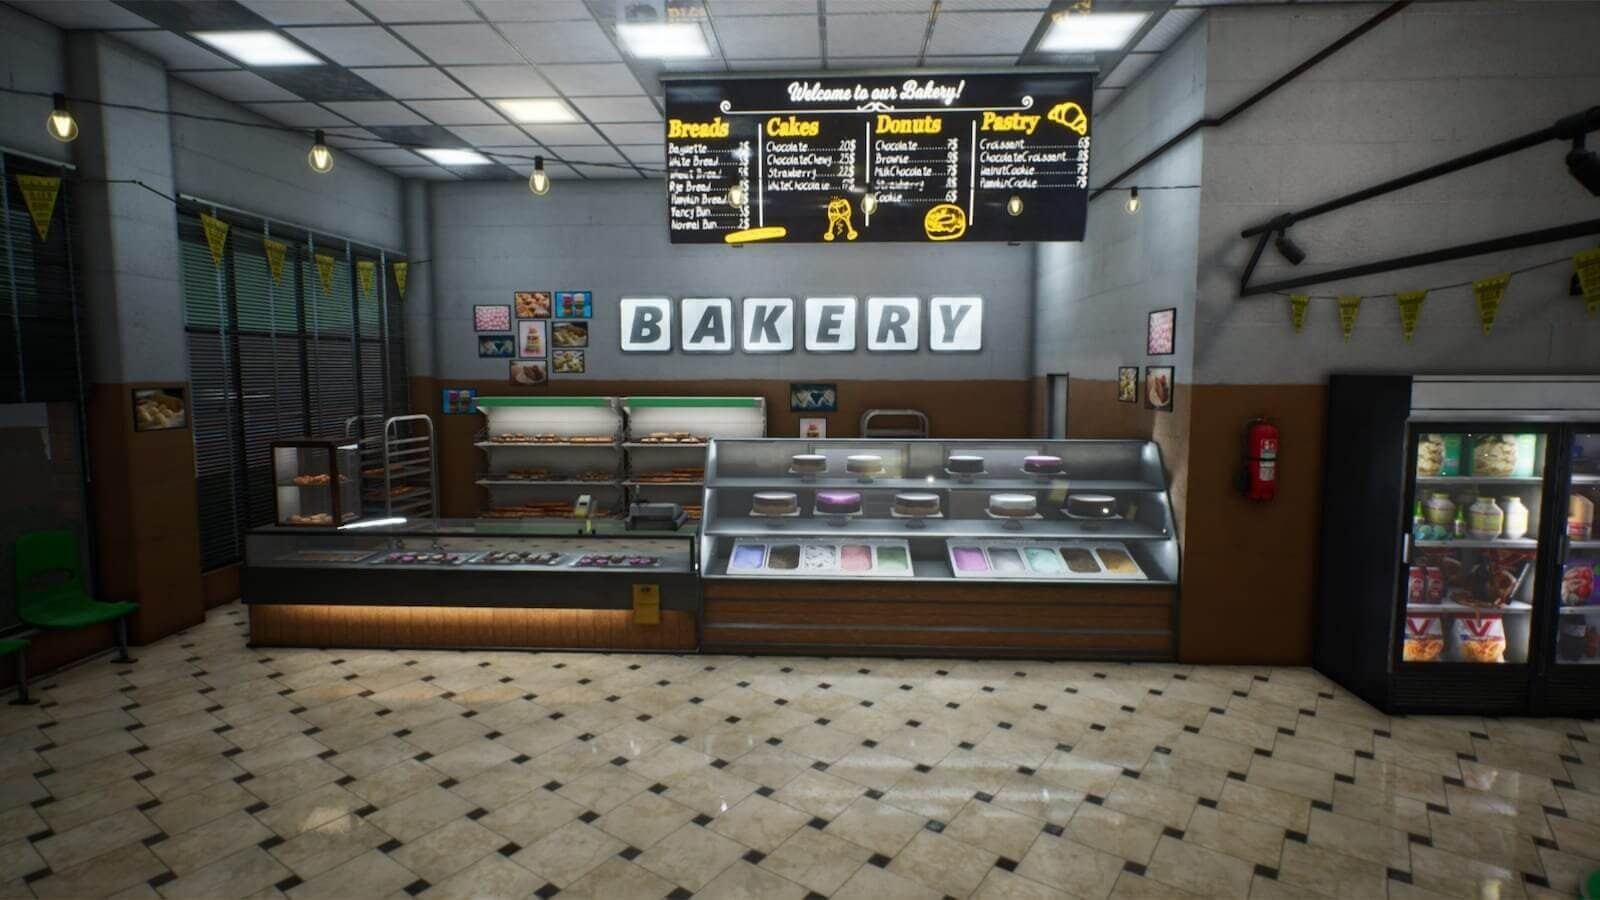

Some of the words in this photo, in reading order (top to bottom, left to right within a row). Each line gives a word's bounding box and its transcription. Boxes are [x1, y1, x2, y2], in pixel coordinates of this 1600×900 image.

[787, 81, 852, 102] Welcome
[853, 83, 869, 100] to
[871, 86, 898, 100] our
[900, 79, 966, 105] Bakery!
[668, 116, 730, 138] Breads
[766, 116, 819, 136] Cakes
[875, 114, 942, 134] Donuts
[981, 111, 1041, 135] Pastry
[668, 142, 708, 156] Baguette
[766, 141, 808, 152] Chocolate
[840, 139, 856, 152] 20$
[875, 140, 918, 151] Chocolate
[980, 138, 1024, 150] Croissant
[692, 154, 720, 167] Bread
[840, 152, 856, 165] 25$
[980, 151, 1066, 163] ChocolateCroissant
[768, 167, 816, 180] Strawberry
[874, 165, 932, 176] MilkChocolate
[669, 180, 684, 194] Rye
[685, 180, 711, 192] Bread
[701, 193, 727, 204] Bread
[874, 191, 902, 202] Cookie
[696, 205, 711, 217] Bun
[702, 218, 717, 230] Bun
[629, 304, 972, 344] BAKERY
